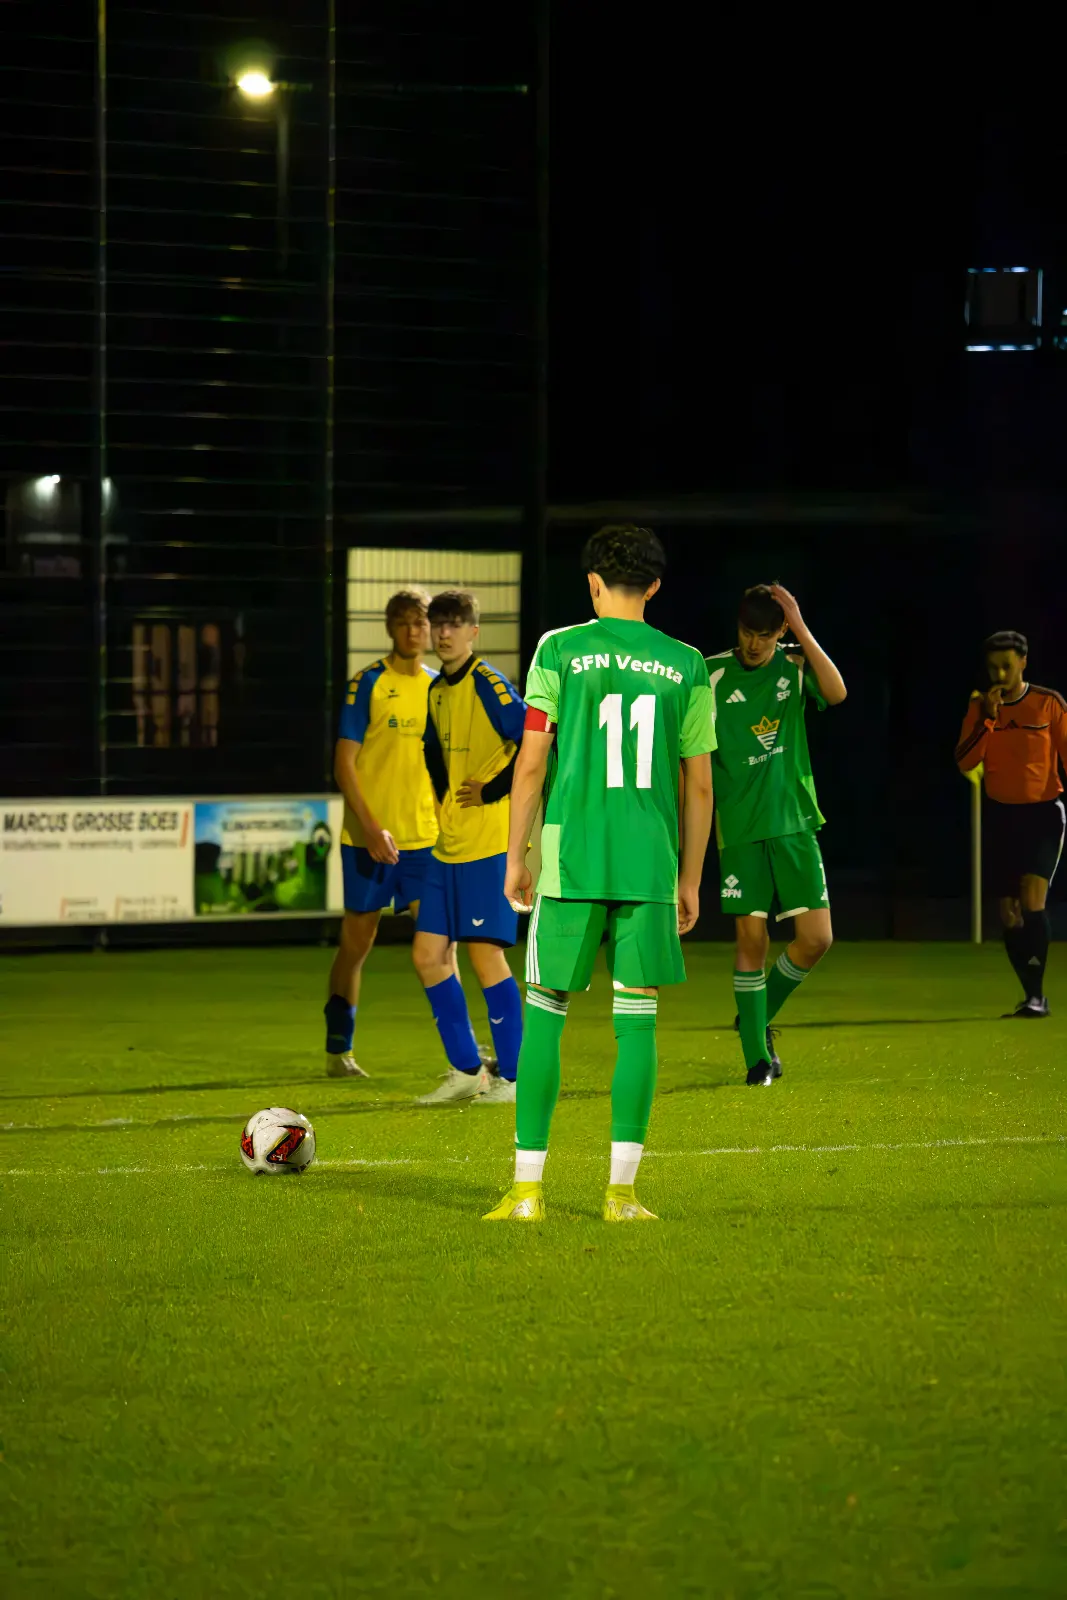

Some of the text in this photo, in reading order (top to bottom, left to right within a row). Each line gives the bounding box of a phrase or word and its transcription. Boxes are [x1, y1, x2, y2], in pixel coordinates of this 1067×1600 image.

[571, 653, 684, 685] SFN Vechta
[599, 693, 656, 788] 11
[4, 811, 68, 833] MARCUS
[72, 810, 135, 832] GROSSE
[721, 888, 742, 899] SFN
